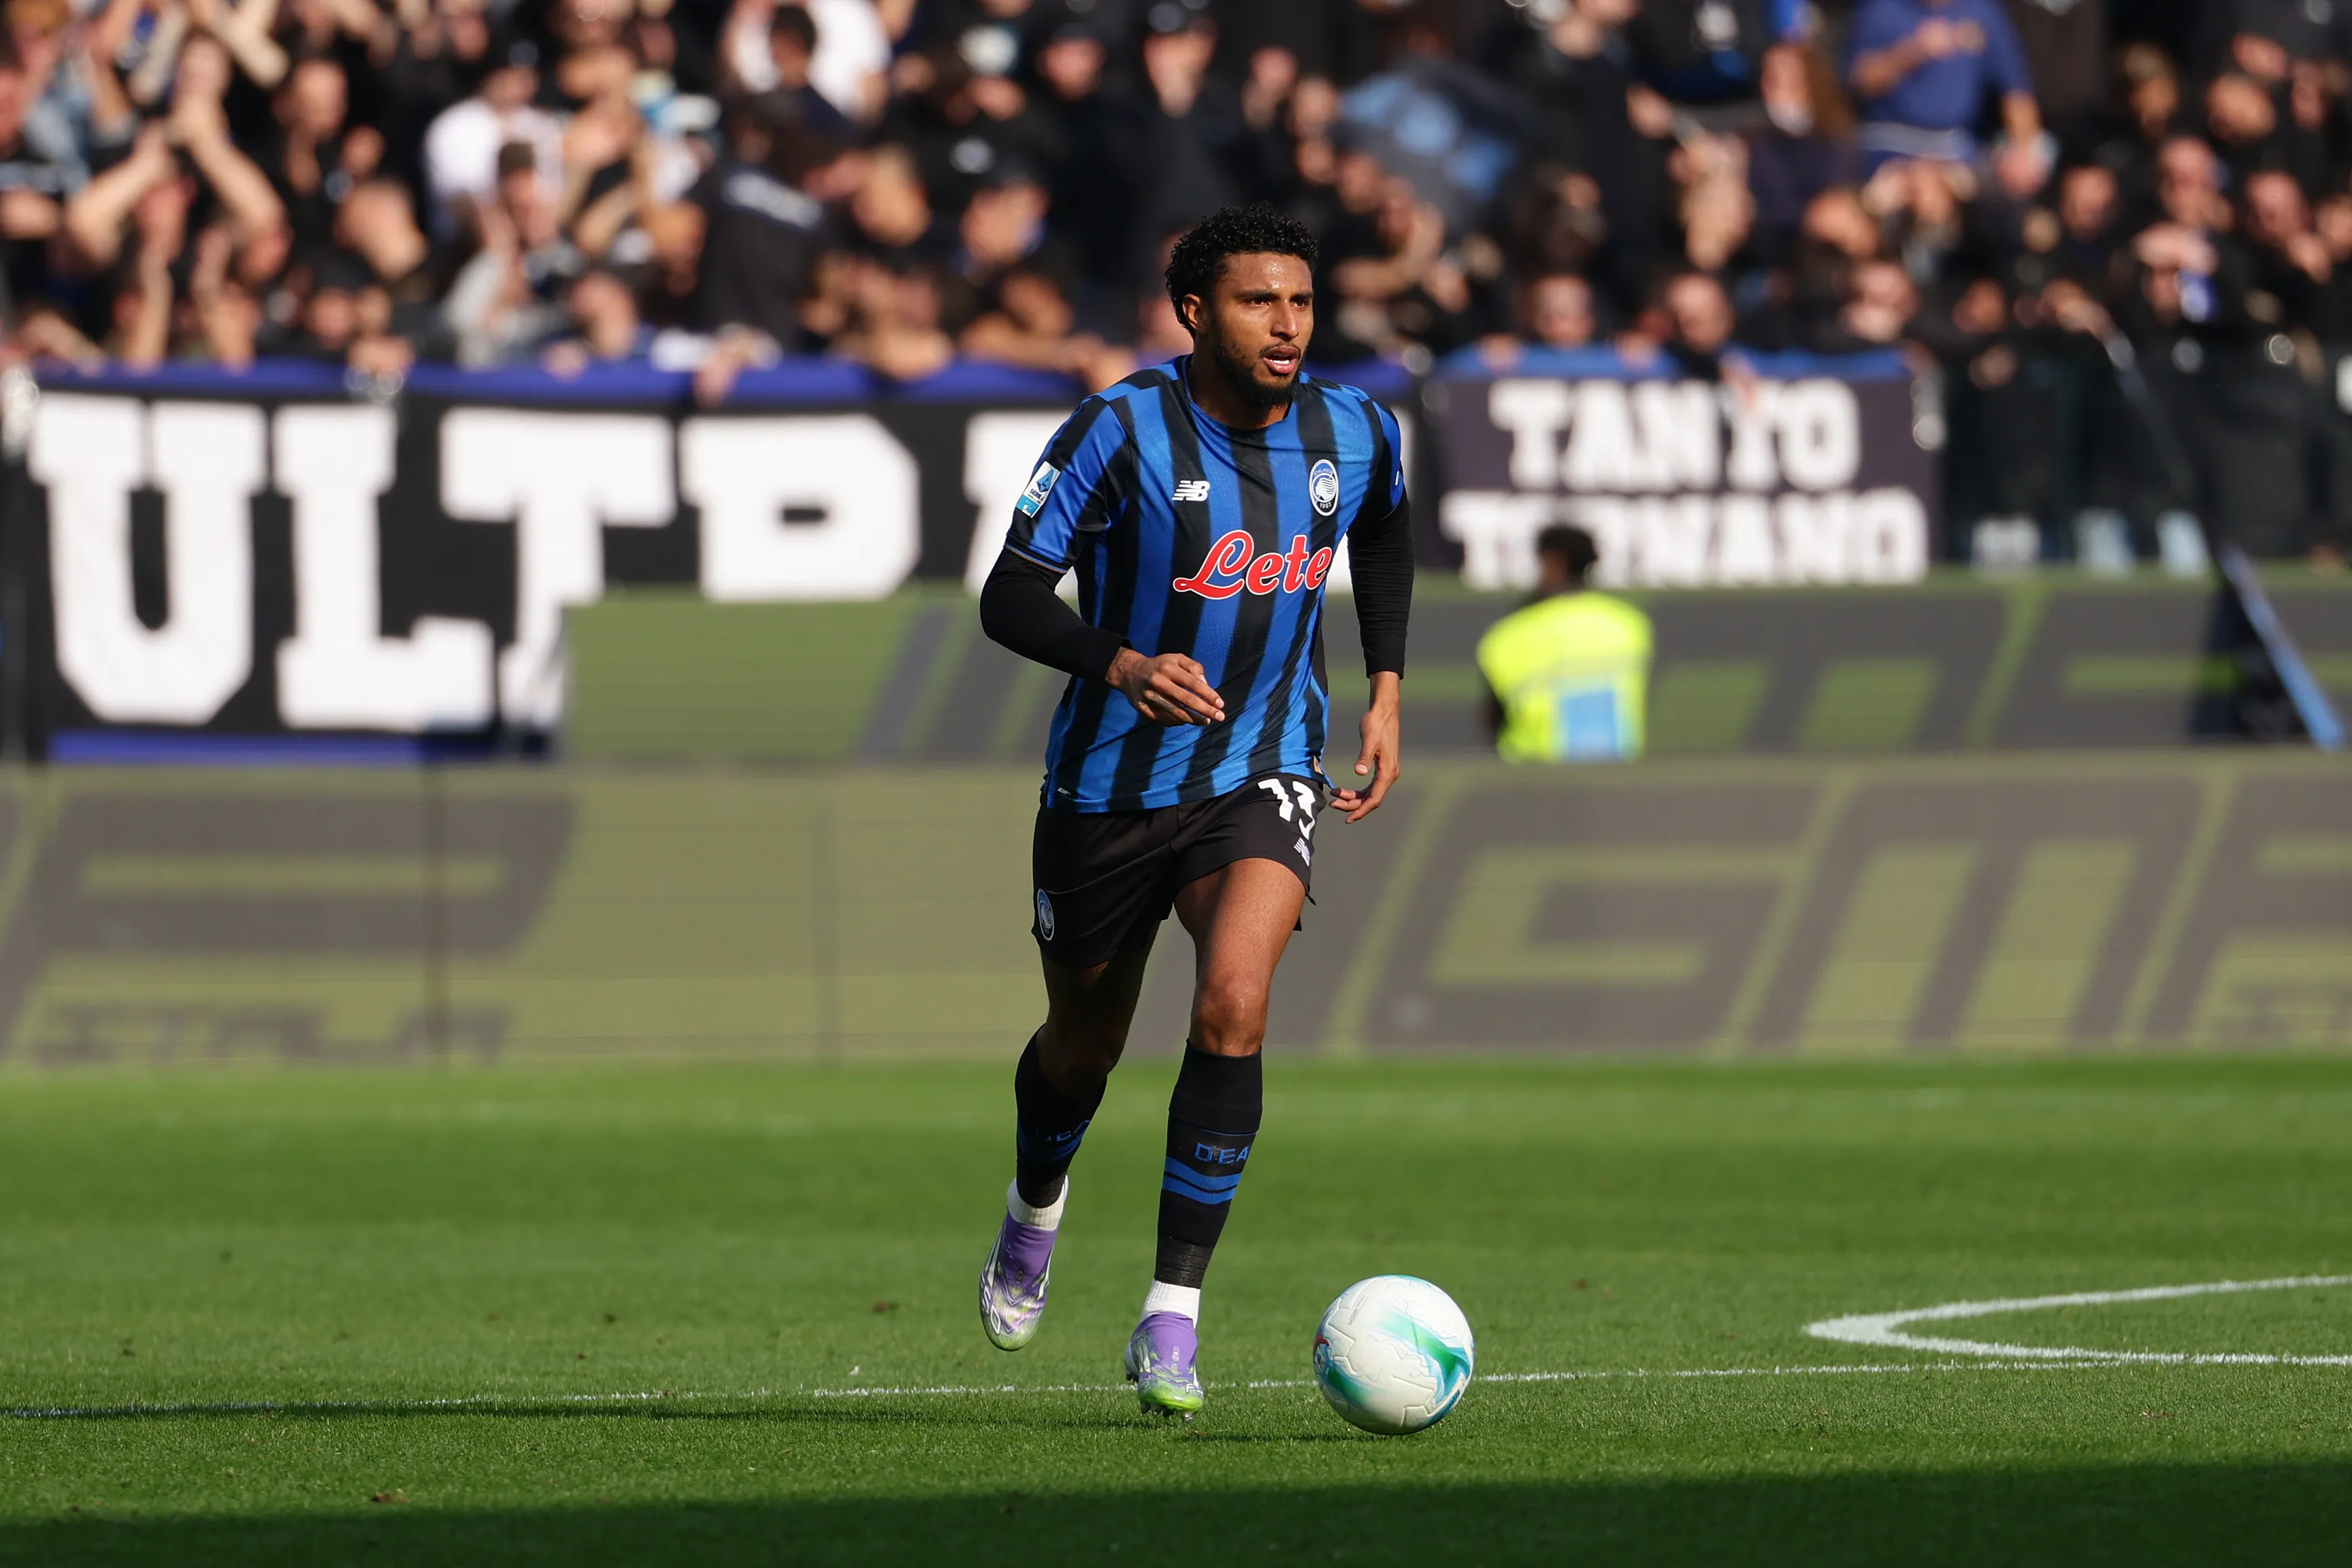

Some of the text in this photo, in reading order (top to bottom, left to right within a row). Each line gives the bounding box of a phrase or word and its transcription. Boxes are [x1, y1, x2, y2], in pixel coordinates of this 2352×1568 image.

[1488, 376, 1862, 492] TANTO
[1173, 529, 1332, 600] Lete
[1194, 1143, 1249, 1164] DEA
